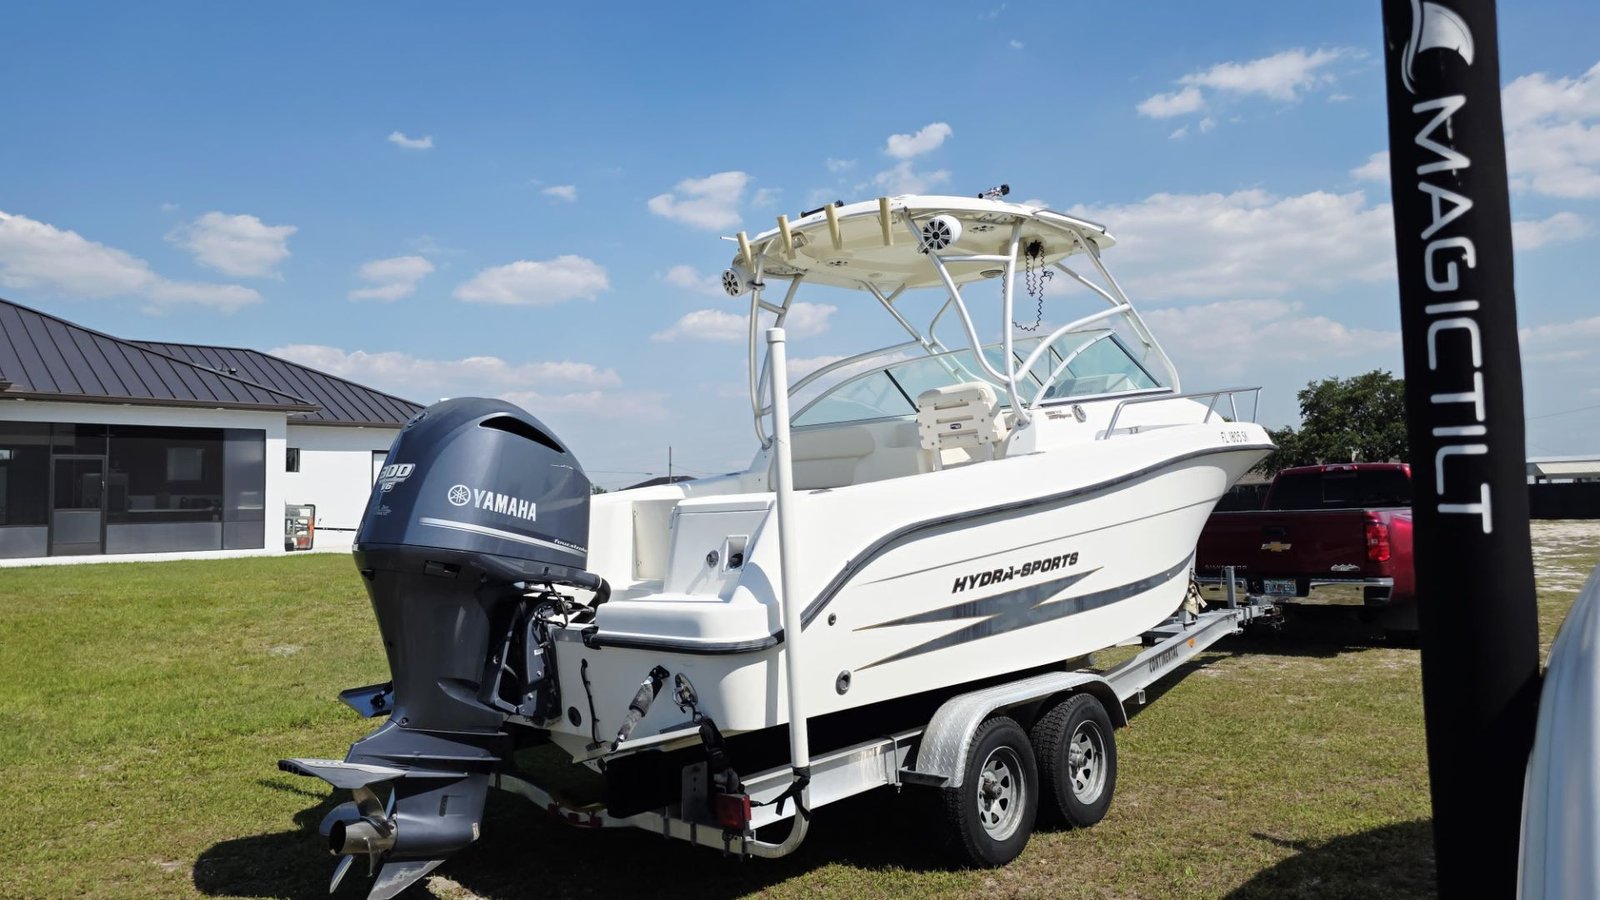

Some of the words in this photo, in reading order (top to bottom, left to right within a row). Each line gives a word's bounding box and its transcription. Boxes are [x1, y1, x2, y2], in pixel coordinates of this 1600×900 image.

[1412, 94, 1493, 535] MAGICTILT
[473, 488, 537, 522] YAMAHA
[952, 552, 1079, 593] HYDRA-SPORTS
